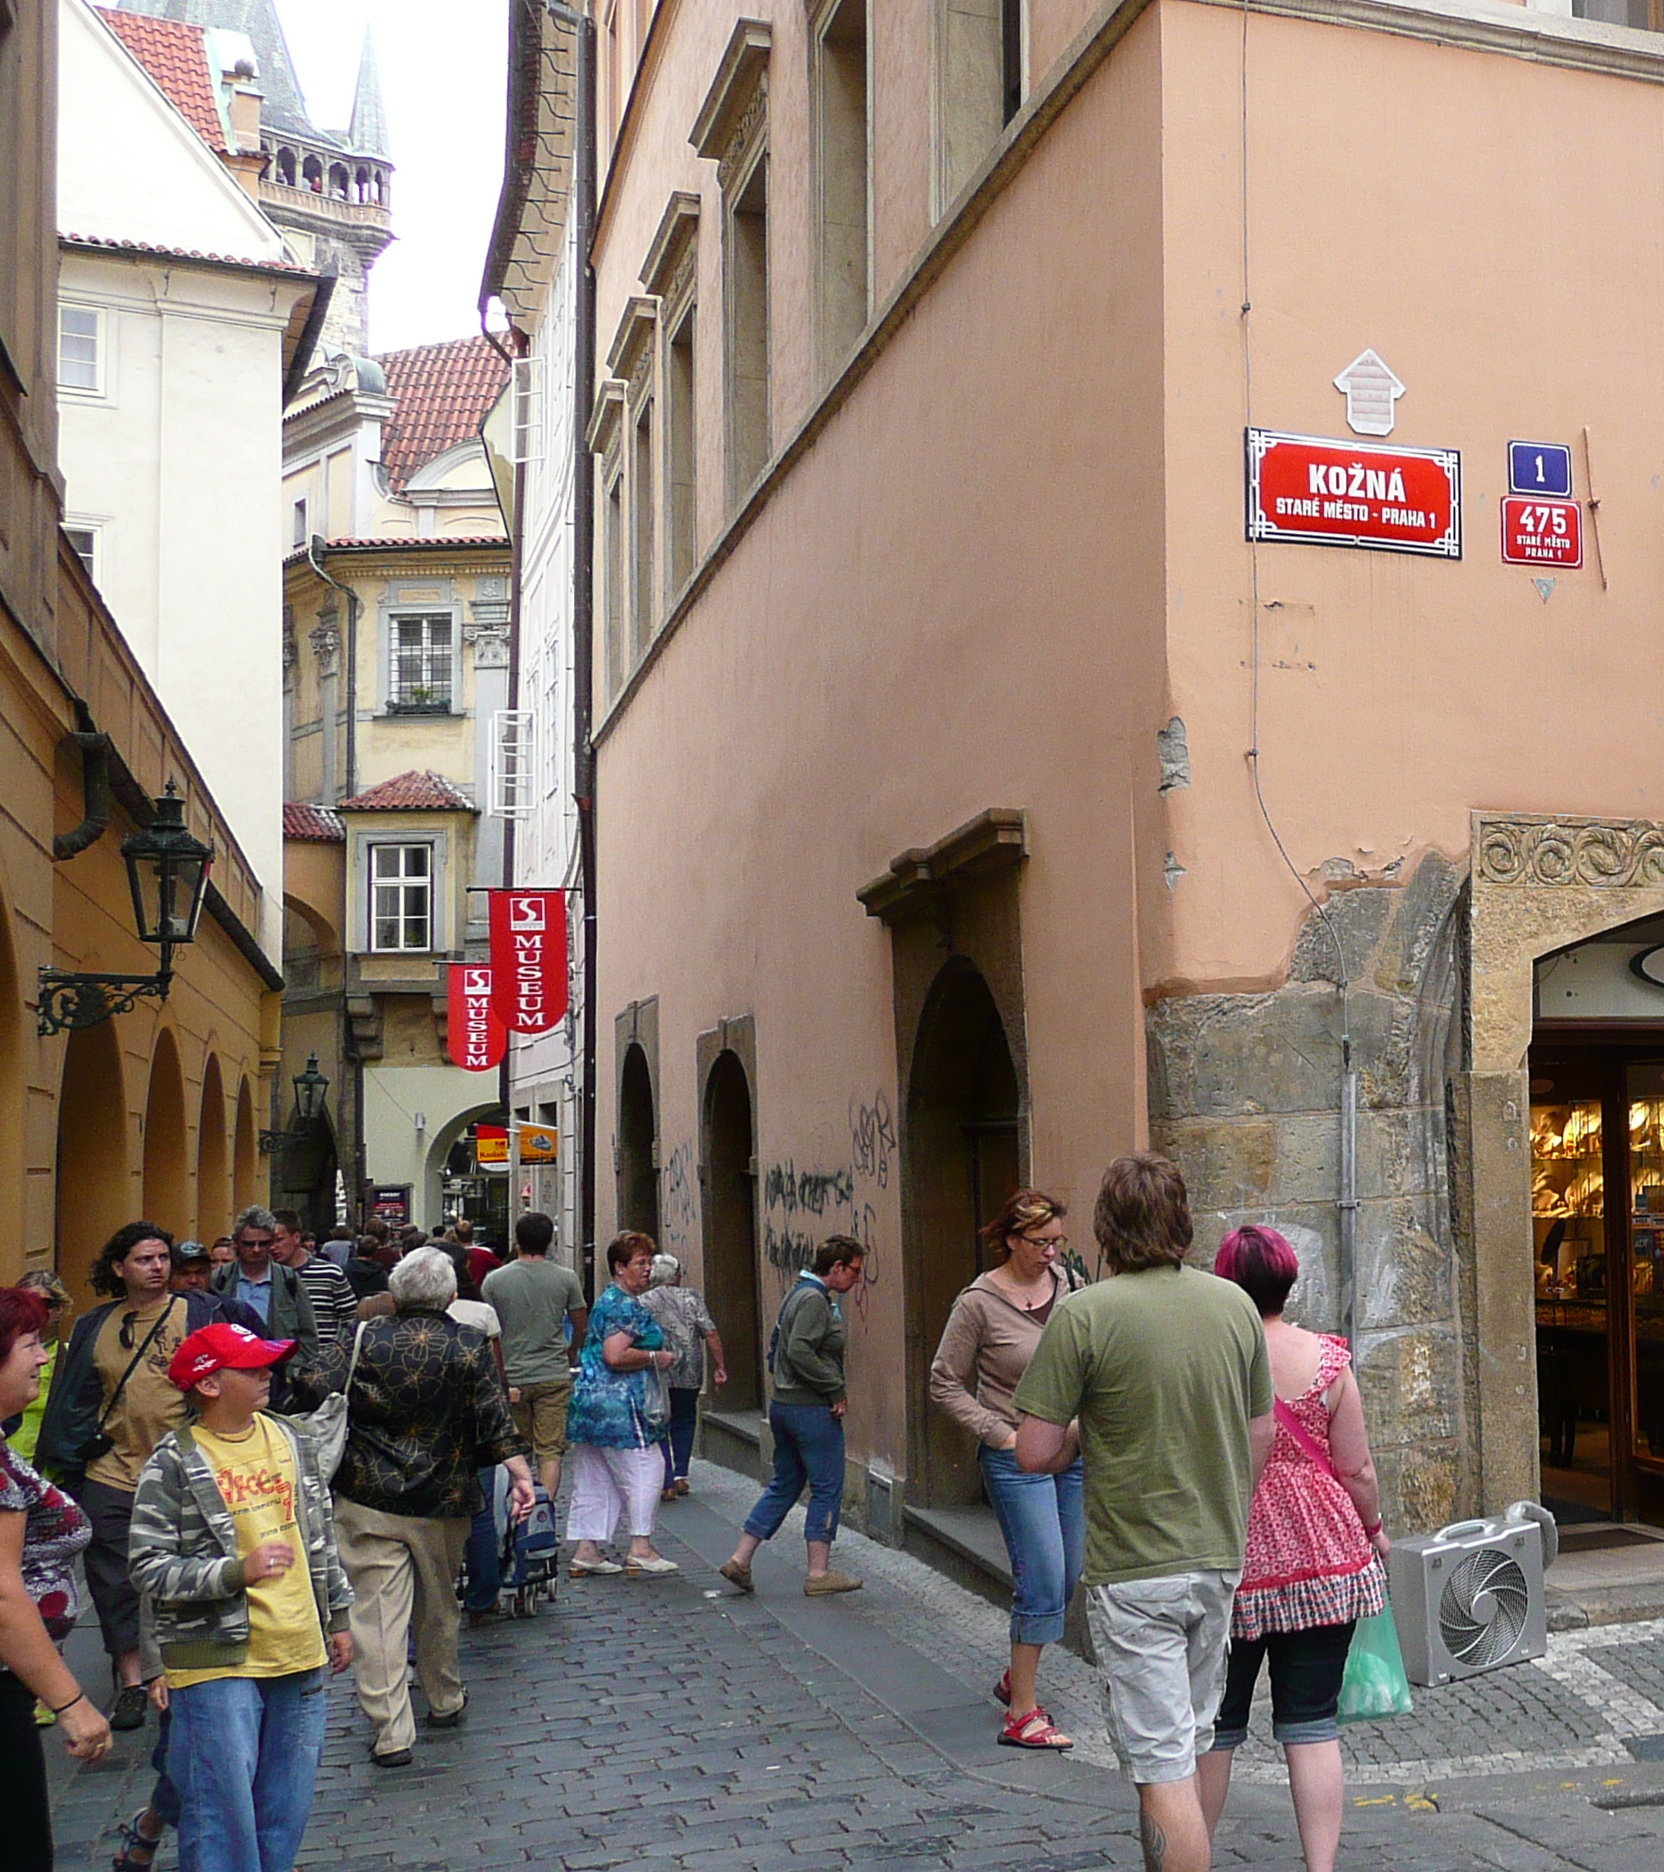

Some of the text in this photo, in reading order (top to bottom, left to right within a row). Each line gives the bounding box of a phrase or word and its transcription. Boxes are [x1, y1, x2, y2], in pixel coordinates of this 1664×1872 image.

[1309, 462, 1407, 503] KOŽNÁ
[1535, 455, 1545, 483] 1
[1276, 497, 1320, 517] STARÉ
[1323, 499, 1369, 521] MĚSTO
[1381, 507, 1426, 528] PRAHA
[1429, 512, 1437, 529] 1
[1519, 505, 1567, 534] 475
[1516, 534, 1571, 549] STARÉ MĚSTO
[1525, 546, 1562, 559] PRAHA 1
[514, 935, 546, 1026] MUSEUM
[465, 997, 489, 1067] MUSEUM
[479, 1151, 506, 1159] Kodak
